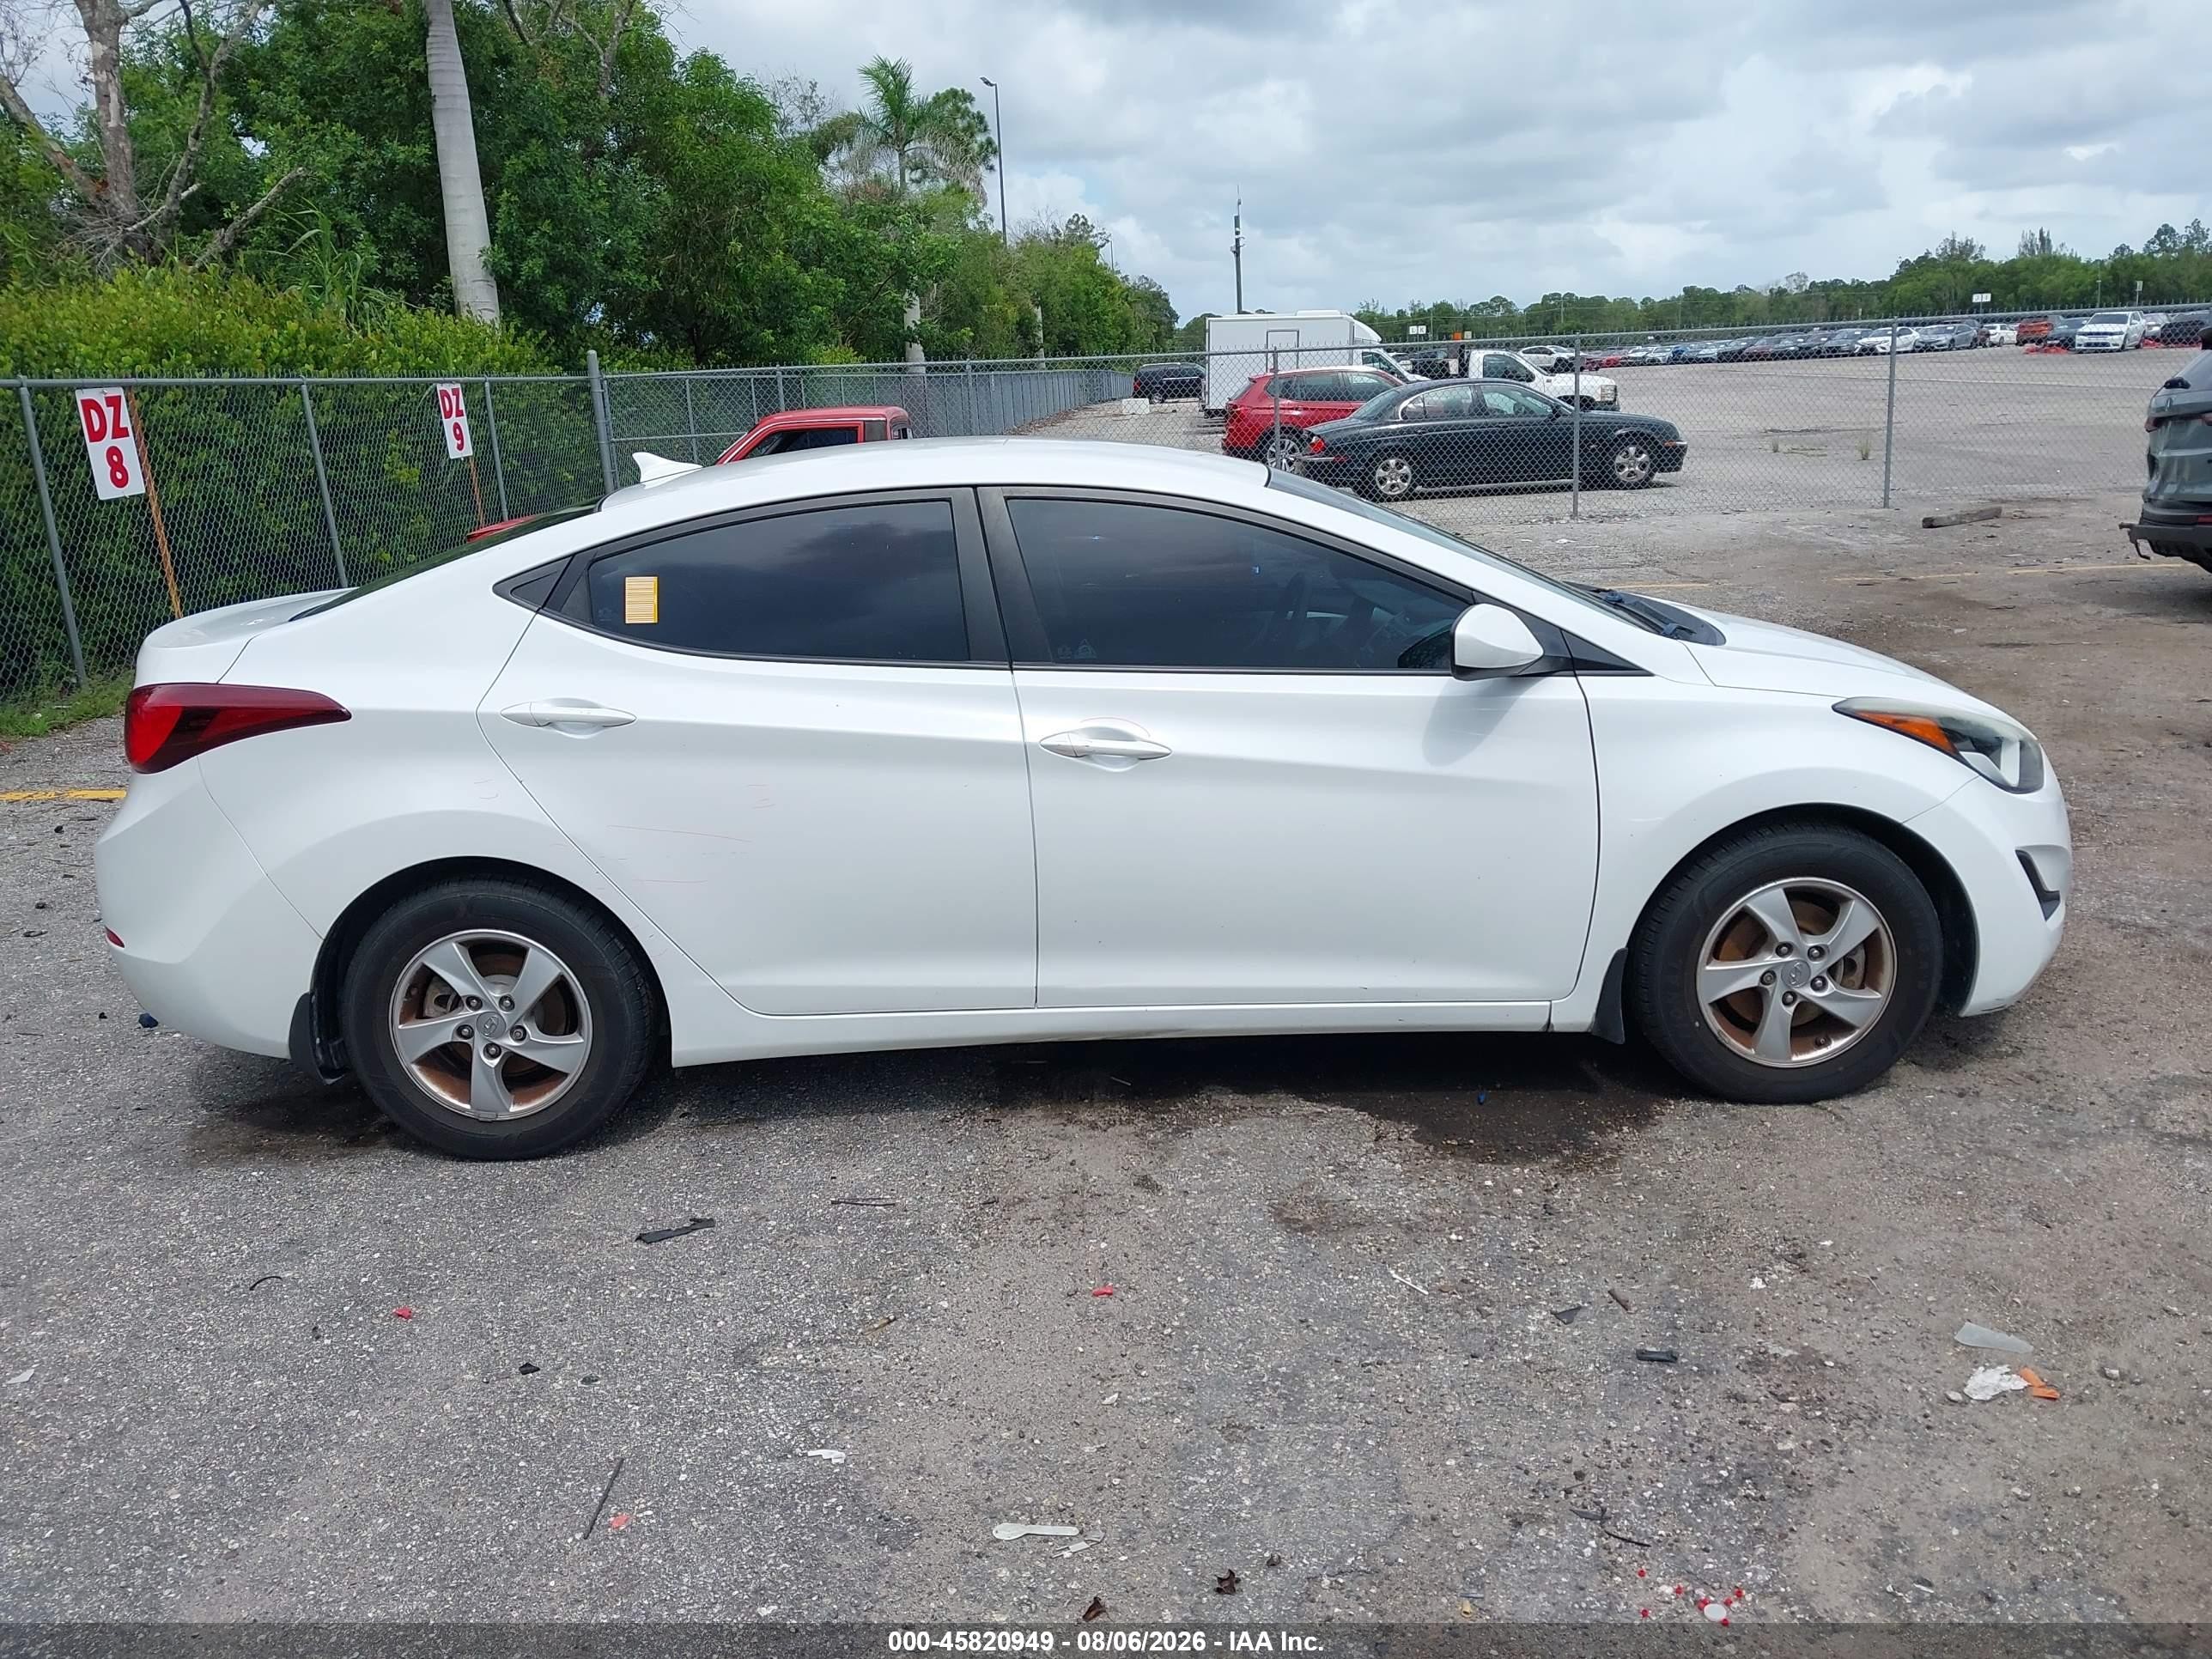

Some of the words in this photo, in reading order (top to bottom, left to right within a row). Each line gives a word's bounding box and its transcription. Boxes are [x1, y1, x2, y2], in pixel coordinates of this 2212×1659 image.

[80, 395, 131, 443] DZ
[439, 387, 465, 420] DZ
[453, 422, 465, 451] 9
[106, 445, 129, 489] 8
